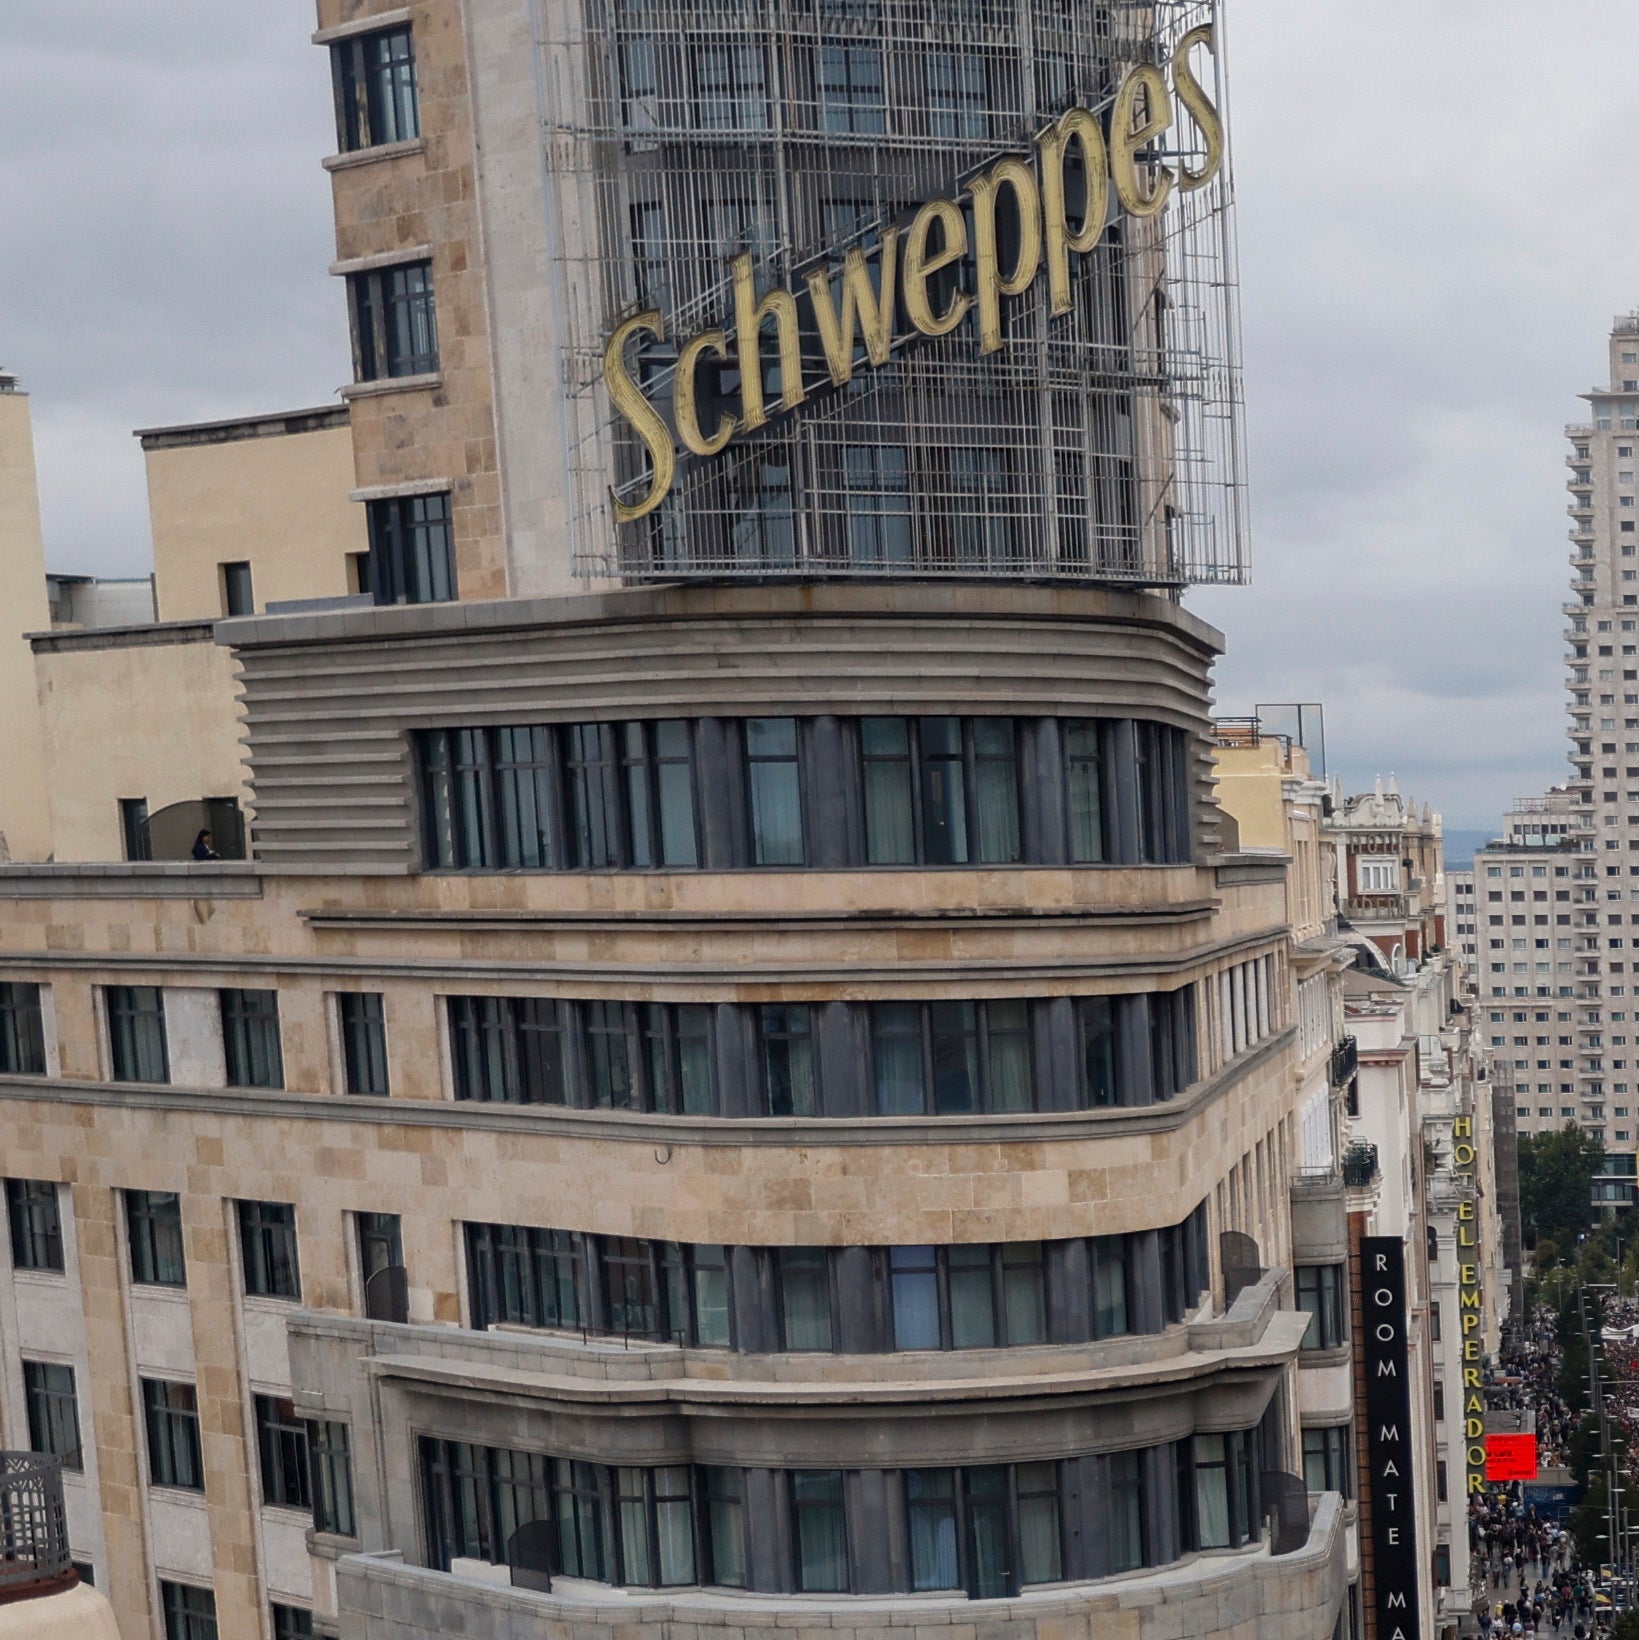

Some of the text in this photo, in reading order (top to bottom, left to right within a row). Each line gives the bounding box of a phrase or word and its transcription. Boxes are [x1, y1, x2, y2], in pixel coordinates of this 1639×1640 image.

[602, 22, 1225, 524] Schweppes
[1374, 1254, 1398, 1377] ROOM
[1460, 1264, 1487, 1493] EMPERADOR
[1380, 1425, 1400, 1545] MATE
